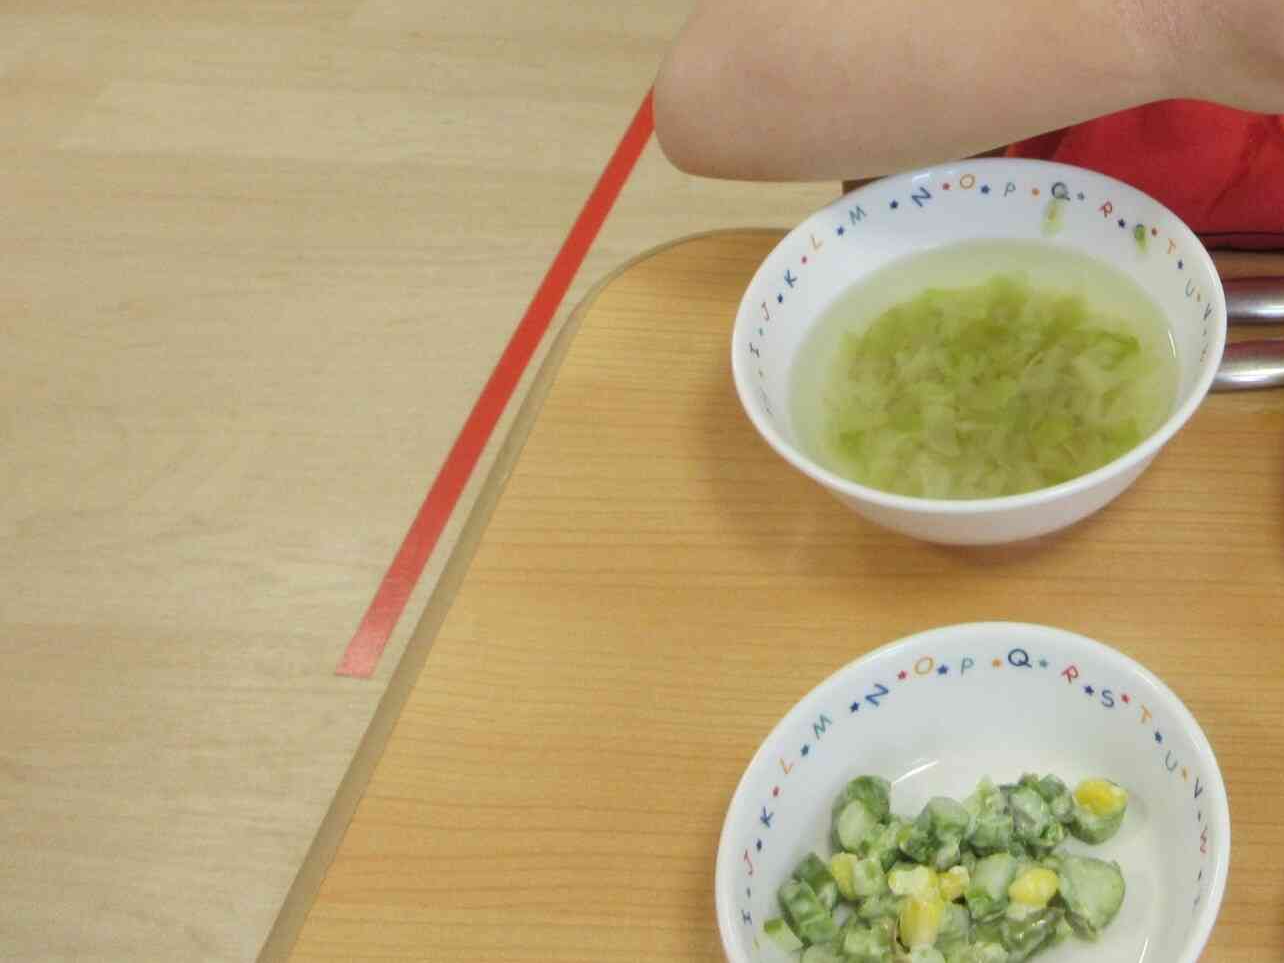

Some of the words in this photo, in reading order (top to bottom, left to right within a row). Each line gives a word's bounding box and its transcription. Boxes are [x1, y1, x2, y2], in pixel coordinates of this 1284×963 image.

[760, 301, 770, 322] J
[783, 270, 799, 288] K
[811, 234, 823, 250] L
[848, 205, 867, 226] M
[911, 187, 933, 208] N
[959, 174, 976, 190] O
[1004, 182, 1017, 198] P
[1051, 182, 1071, 201] Q
[1098, 201, 1113, 218] R
[1167, 238, 1177, 254] T
[744, 849, 754, 876] J
[760, 806, 775, 828] K
[780, 757, 793, 775] L
[813, 715, 832, 738] M
[866, 684, 889, 705] N
[914, 656, 934, 675] O
[960, 657, 974, 676] P
[1008, 649, 1032, 668] Q
[1062, 665, 1081, 684] R
[1101, 689, 1116, 708] S
[1137, 705, 1152, 723] T
[1165, 750, 1178, 771] U
